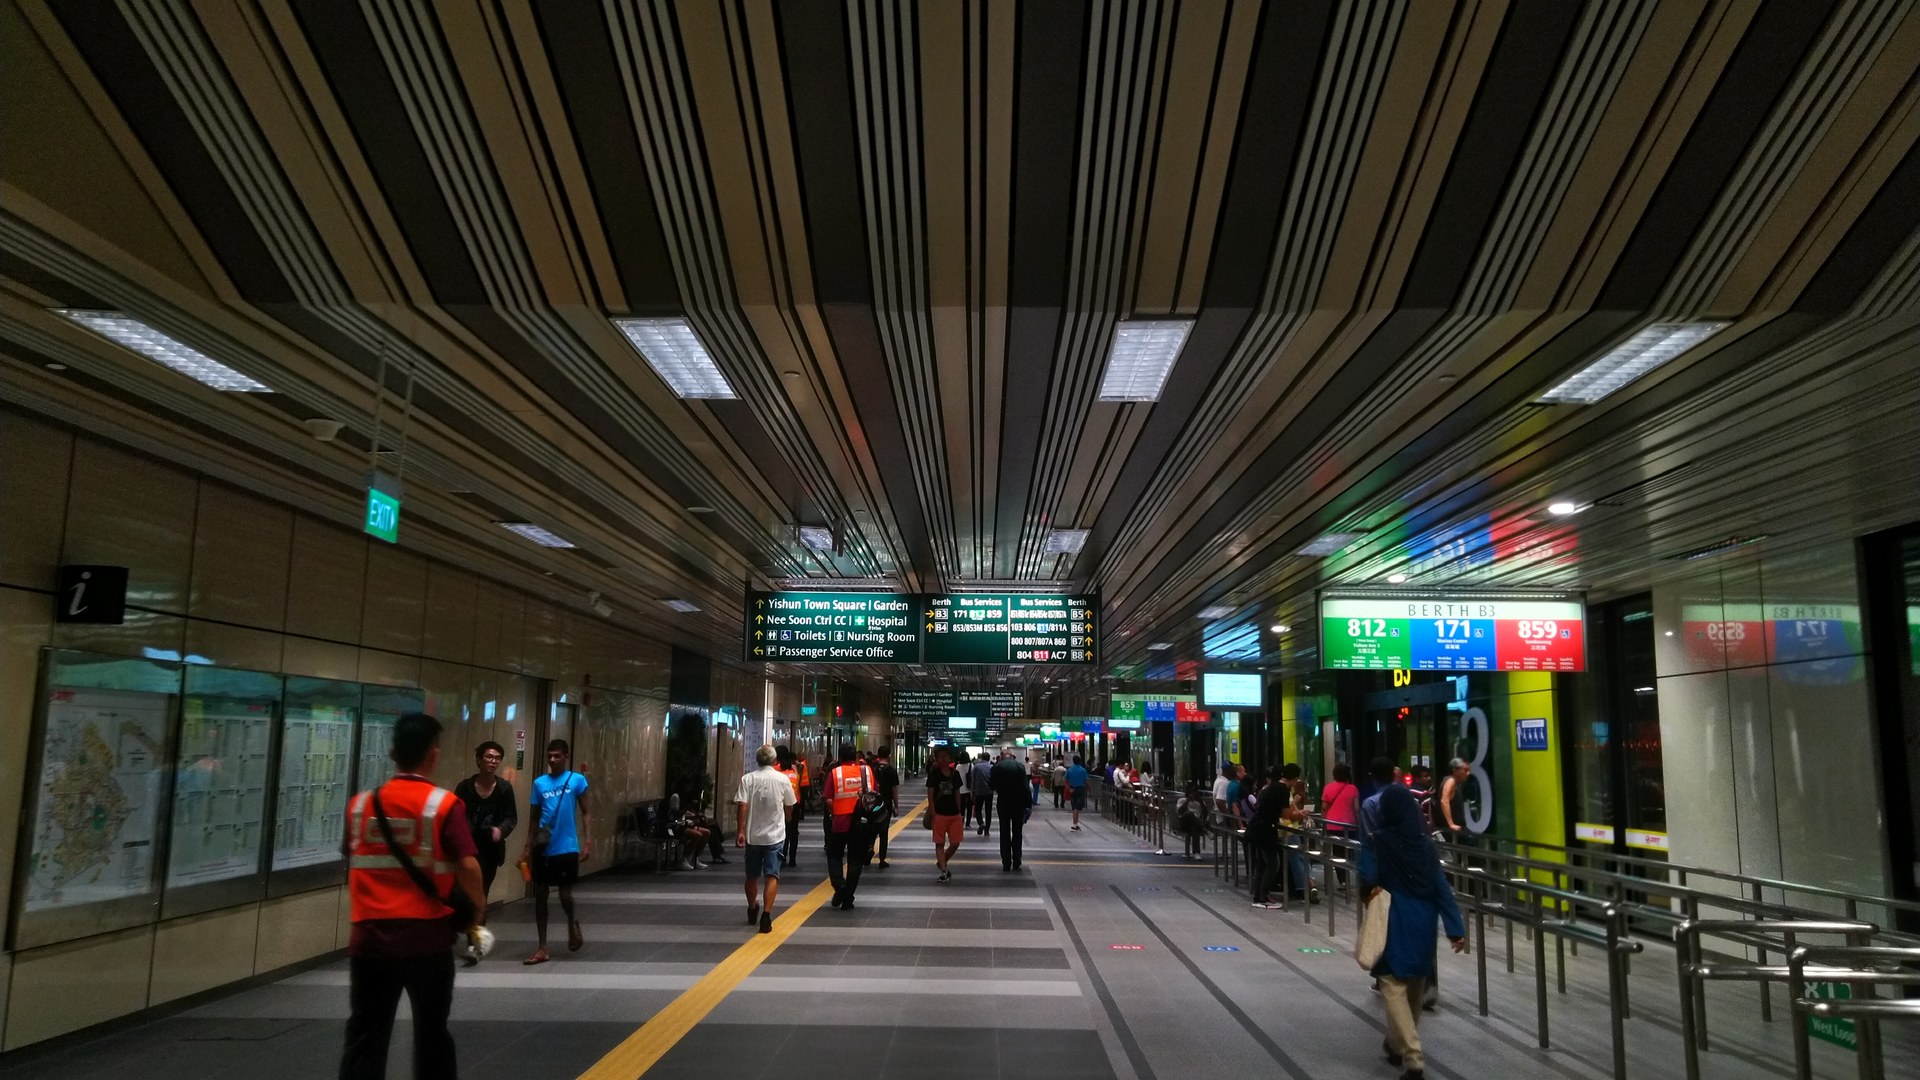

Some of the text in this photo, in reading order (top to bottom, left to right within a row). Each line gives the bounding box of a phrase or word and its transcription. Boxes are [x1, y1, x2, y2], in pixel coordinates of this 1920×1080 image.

[370, 499, 391, 530] EXIT
[768, 599, 908, 612] Yishun Town Square Garden
[1408, 604, 1495, 617] BERTH B3
[936, 610, 947, 618] B3
[767, 615, 907, 628] Nee Soon Ctrl CC Hospital
[936, 623, 947, 632] B4
[953, 624, 983, 632] 853/853M
[1024, 624, 1036, 632] 806
[1348, 619, 1386, 637] 812
[1434, 620, 1470, 638] 171
[1518, 620, 1557, 638] 859
[794, 630, 915, 643] Toilets Nursing Room
[1011, 637, 1023, 645] 800
[1024, 637, 1053, 646] 807/807A
[1073, 637, 1083, 645] B7
[780, 647, 893, 658] Passenger Service Office
[1017, 651, 1083, 659] 804 811 AC7 B8
[1461, 706, 1492, 834] 3
